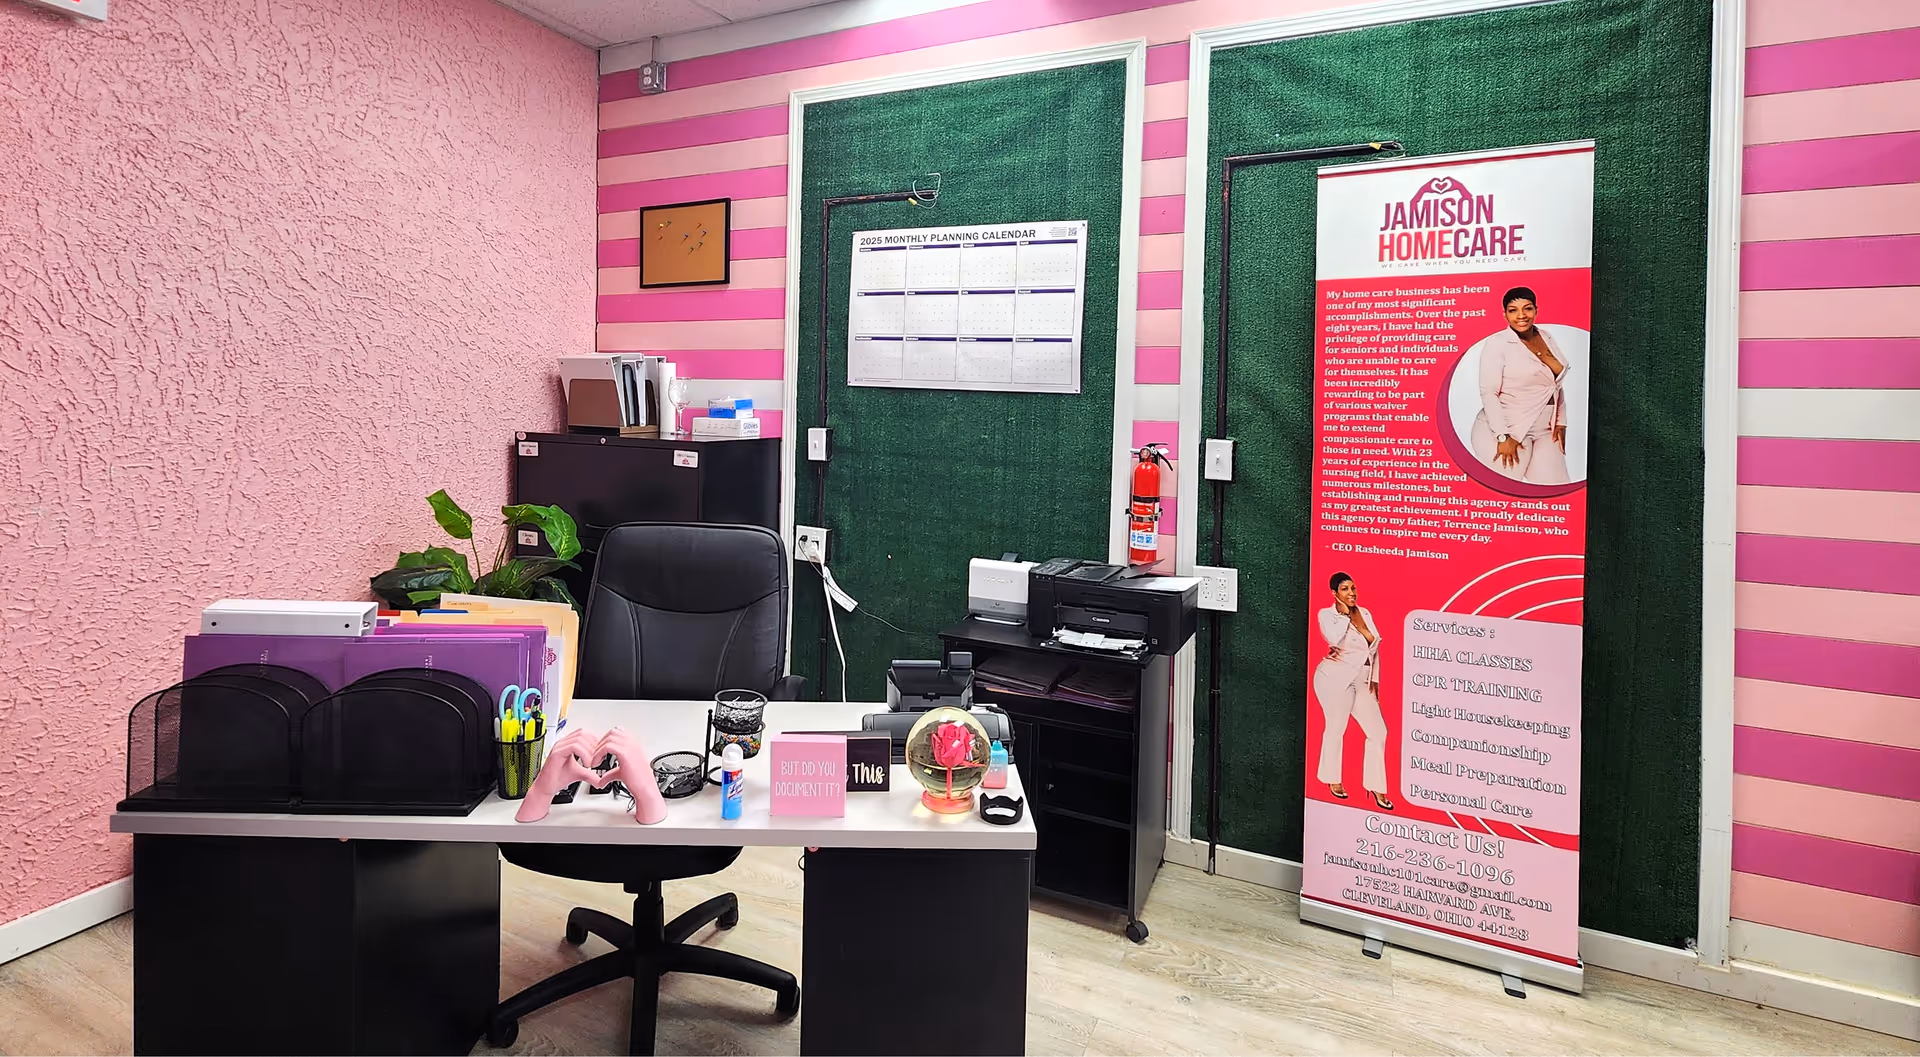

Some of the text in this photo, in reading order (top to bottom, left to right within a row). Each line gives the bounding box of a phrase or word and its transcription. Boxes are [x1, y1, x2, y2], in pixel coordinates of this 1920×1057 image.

[1380, 194, 1494, 231] JAMISON
[860, 230, 1036, 246] 2025 MONTHLY PLANNING CALENDAR
[1378, 224, 1525, 262] HOMECARE
[1326, 291, 1341, 300] My
[1342, 290, 1370, 298] home
[1395, 288, 1441, 296] business
[1442, 286, 1461, 294] has
[1463, 285, 1490, 294] been
[1345, 301, 1357, 309] of
[1357, 302, 1373, 310] my
[1374, 300, 1400, 308] most
[1401, 298, 1456, 309] significant
[1325, 309, 1486, 322] accomplishments. Over the past
[1325, 321, 1454, 334] eight years, I have had the
[1325, 334, 1368, 345] privilege
[1369, 333, 1381, 342] of
[1381, 333, 1432, 344] providing
[1325, 344, 1458, 354] for seniors and individuals
[1325, 357, 1345, 365] who
[1365, 356, 1400, 364] unable
[1325, 367, 1428, 376] for themselves. It has
[1324, 379, 1400, 389] been incredibly
[1324, 390, 1374, 400] rewarding
[1388, 390, 1401, 399] be
[1403, 392, 1425, 400] part
[1324, 401, 1408, 410] of various waiver
[1323, 413, 1429, 422] programs that enable
[1351, 424, 1385, 433] extend
[1323, 436, 1396, 445] compassionate
[1323, 445, 1349, 454] those
[1363, 447, 1390, 455] need.
[1392, 448, 1417, 456] With
[1419, 449, 1432, 457] 23
[1322, 458, 1450, 469] years of experience in the
[1322, 469, 1467, 482] nursing field, I have achieved
[1322, 480, 1451, 493] numerous milestones, but
[1322, 490, 1381, 502] establishing
[1382, 493, 1402, 502] and
[1404, 495, 1446, 506] running
[1448, 496, 1469, 505] this
[1470, 500, 1509, 510] agency
[1511, 501, 1549, 510] stands
[1334, 503, 1349, 511] my
[1350, 504, 1391, 512] greatest
[1393, 505, 1462, 517] achievement.
[1464, 509, 1468, 517] I
[1470, 511, 1514, 522] proudly
[1516, 512, 1565, 523] dedicate
[1321, 512, 1569, 535] this agency to my father, Terrence Jamison, who
[1321, 524, 1368, 534] continues
[1382, 527, 1419, 538] inspire
[1421, 531, 1437, 539] me
[1439, 533, 1469, 542] every
[1471, 533, 1492, 544] day.
[1332, 543, 1352, 552] CEO
[1355, 544, 1404, 556] Rasheeda
[1406, 548, 1449, 560] Jamison
[1413, 618, 1485, 638] Services
[1413, 645, 1533, 672] HHA CLASSES
[1412, 674, 1542, 703] CPR TRAINING
[1412, 702, 1570, 739] Light Housekeeping
[1411, 729, 1551, 766] Companionship
[781, 761, 800, 776] BUT
[802, 761, 816, 776] DID
[818, 761, 836, 777] YOU
[852, 762, 886, 784] This
[1411, 756, 1567, 795] Meal Preparation
[775, 782, 841, 797] DOCUMENT IT?
[1410, 784, 1533, 818] Personal Care
[1365, 816, 1505, 859] Contact Us!
[1356, 838, 1515, 886] 216-236-1096
[1323, 852, 1552, 912] jamisonhc101care@gmail.com
[1355, 875, 1515, 921] 17522 HARVARD AVE.
[1342, 888, 1529, 941] CLEVELAND, OHIO 44128
